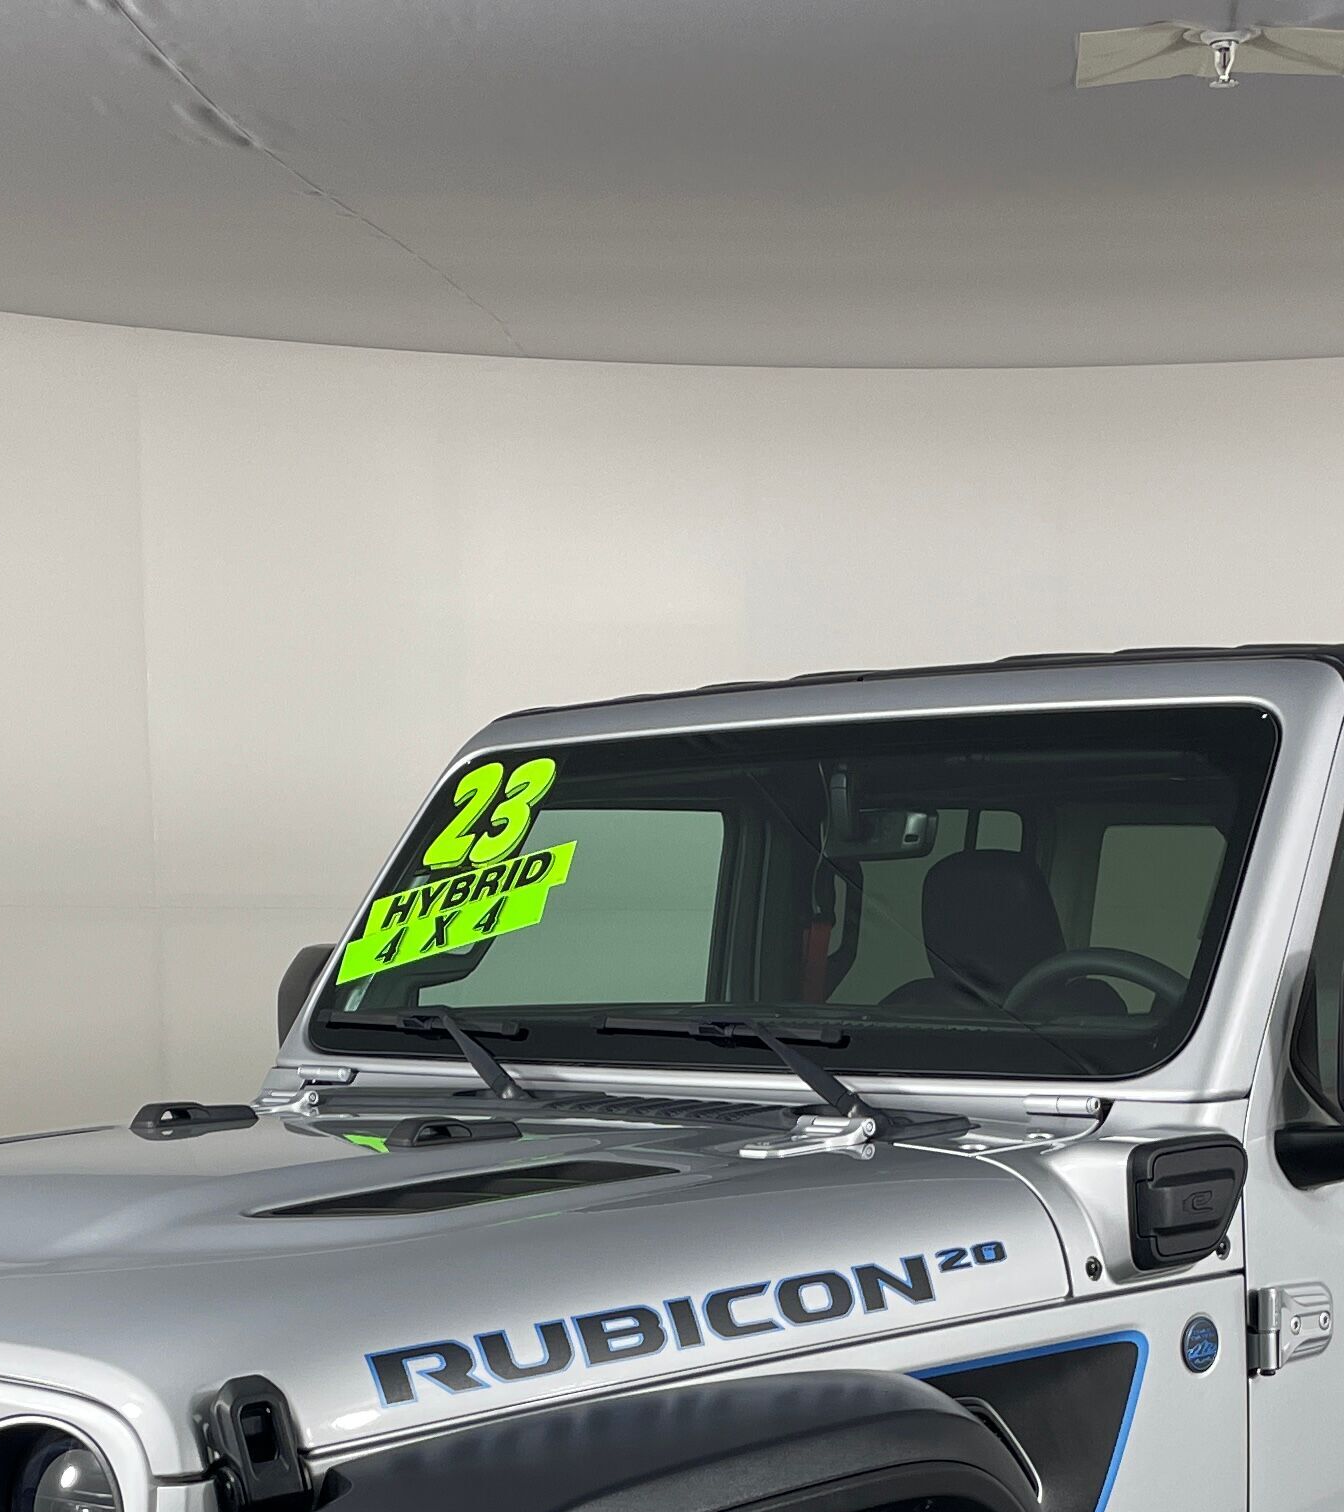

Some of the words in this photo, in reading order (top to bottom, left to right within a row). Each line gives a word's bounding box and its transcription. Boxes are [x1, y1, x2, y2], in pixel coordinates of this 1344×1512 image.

[422, 757, 557, 868] 23
[374, 926, 409, 965] 4
[473, 895, 509, 935] 4
[380, 851, 556, 930] HYBRID
[363, 1254, 938, 1409] RUBICON
[934, 1240, 1008, 1273] 20
